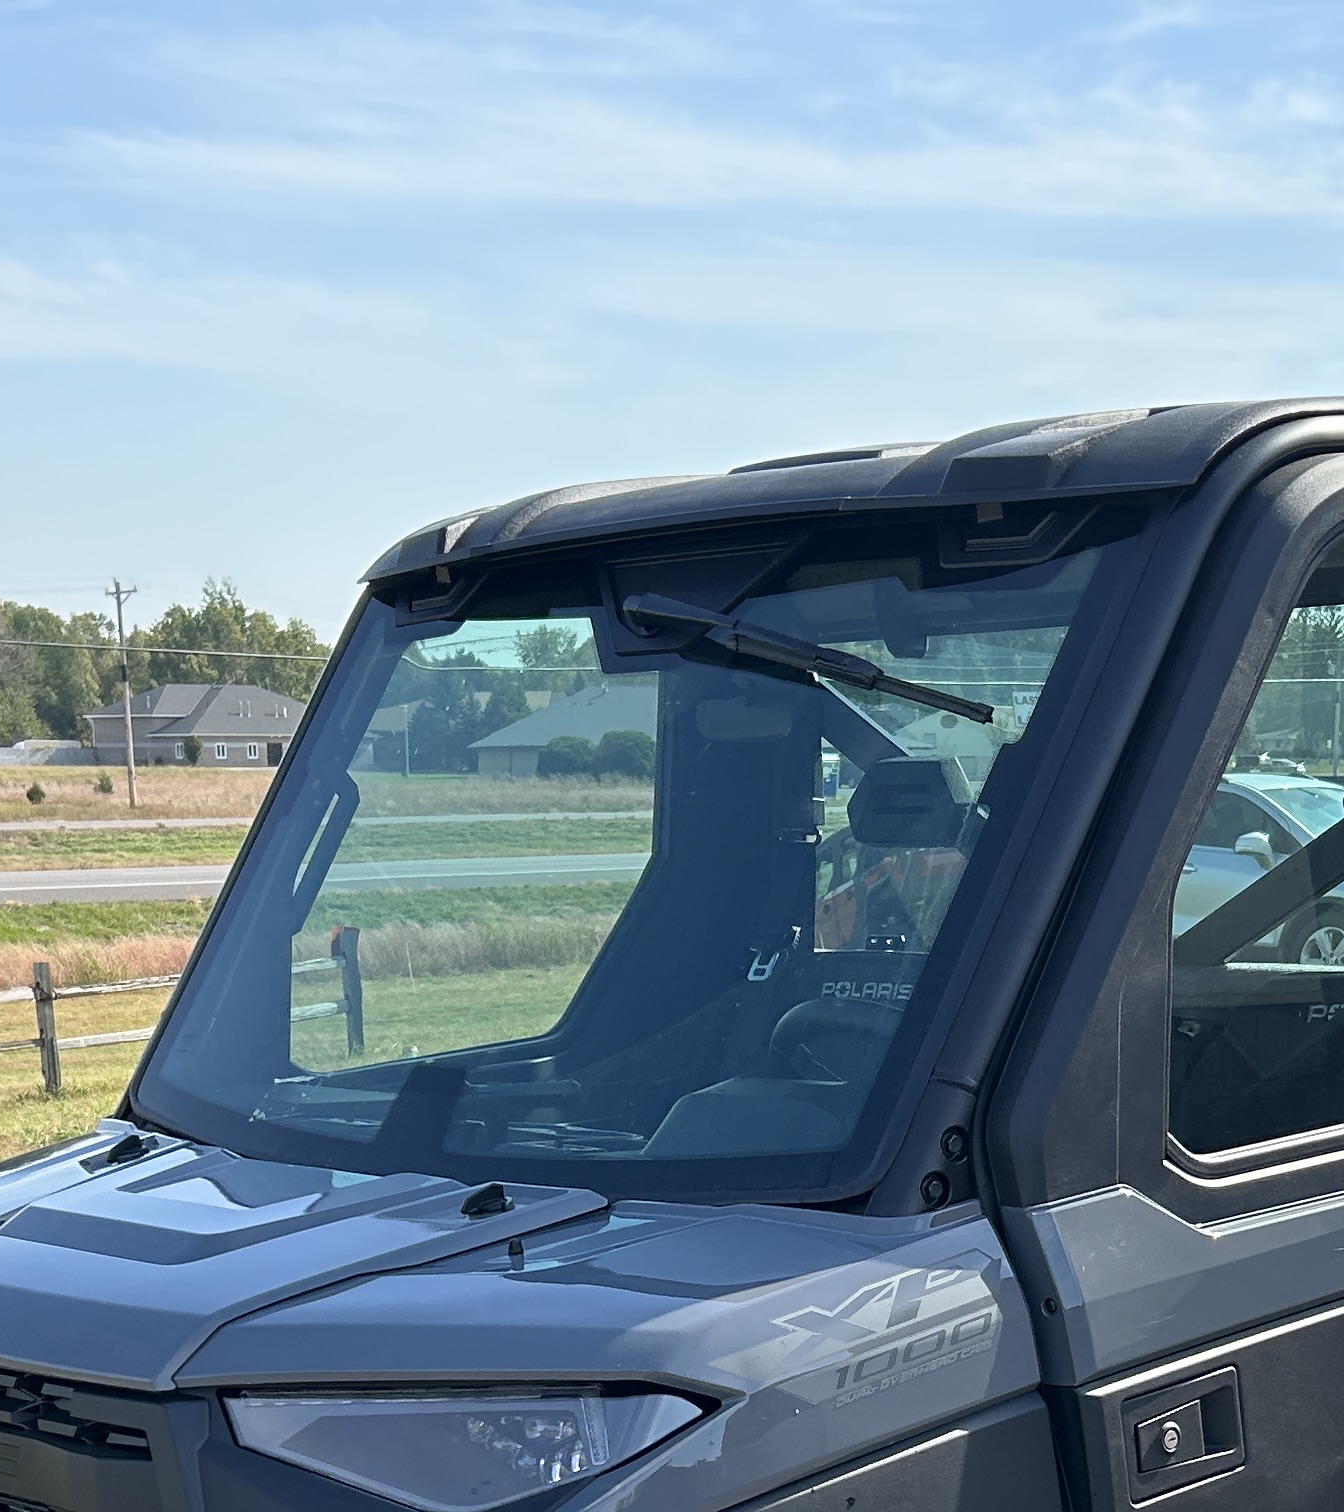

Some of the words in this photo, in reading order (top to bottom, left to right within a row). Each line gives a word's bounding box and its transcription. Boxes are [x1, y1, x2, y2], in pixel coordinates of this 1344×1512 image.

[1014, 695, 1038, 706] LAS
[821, 981, 914, 1000] POLARIS
[769, 1250, 999, 1348] XP
[835, 1311, 993, 1391] 1000
